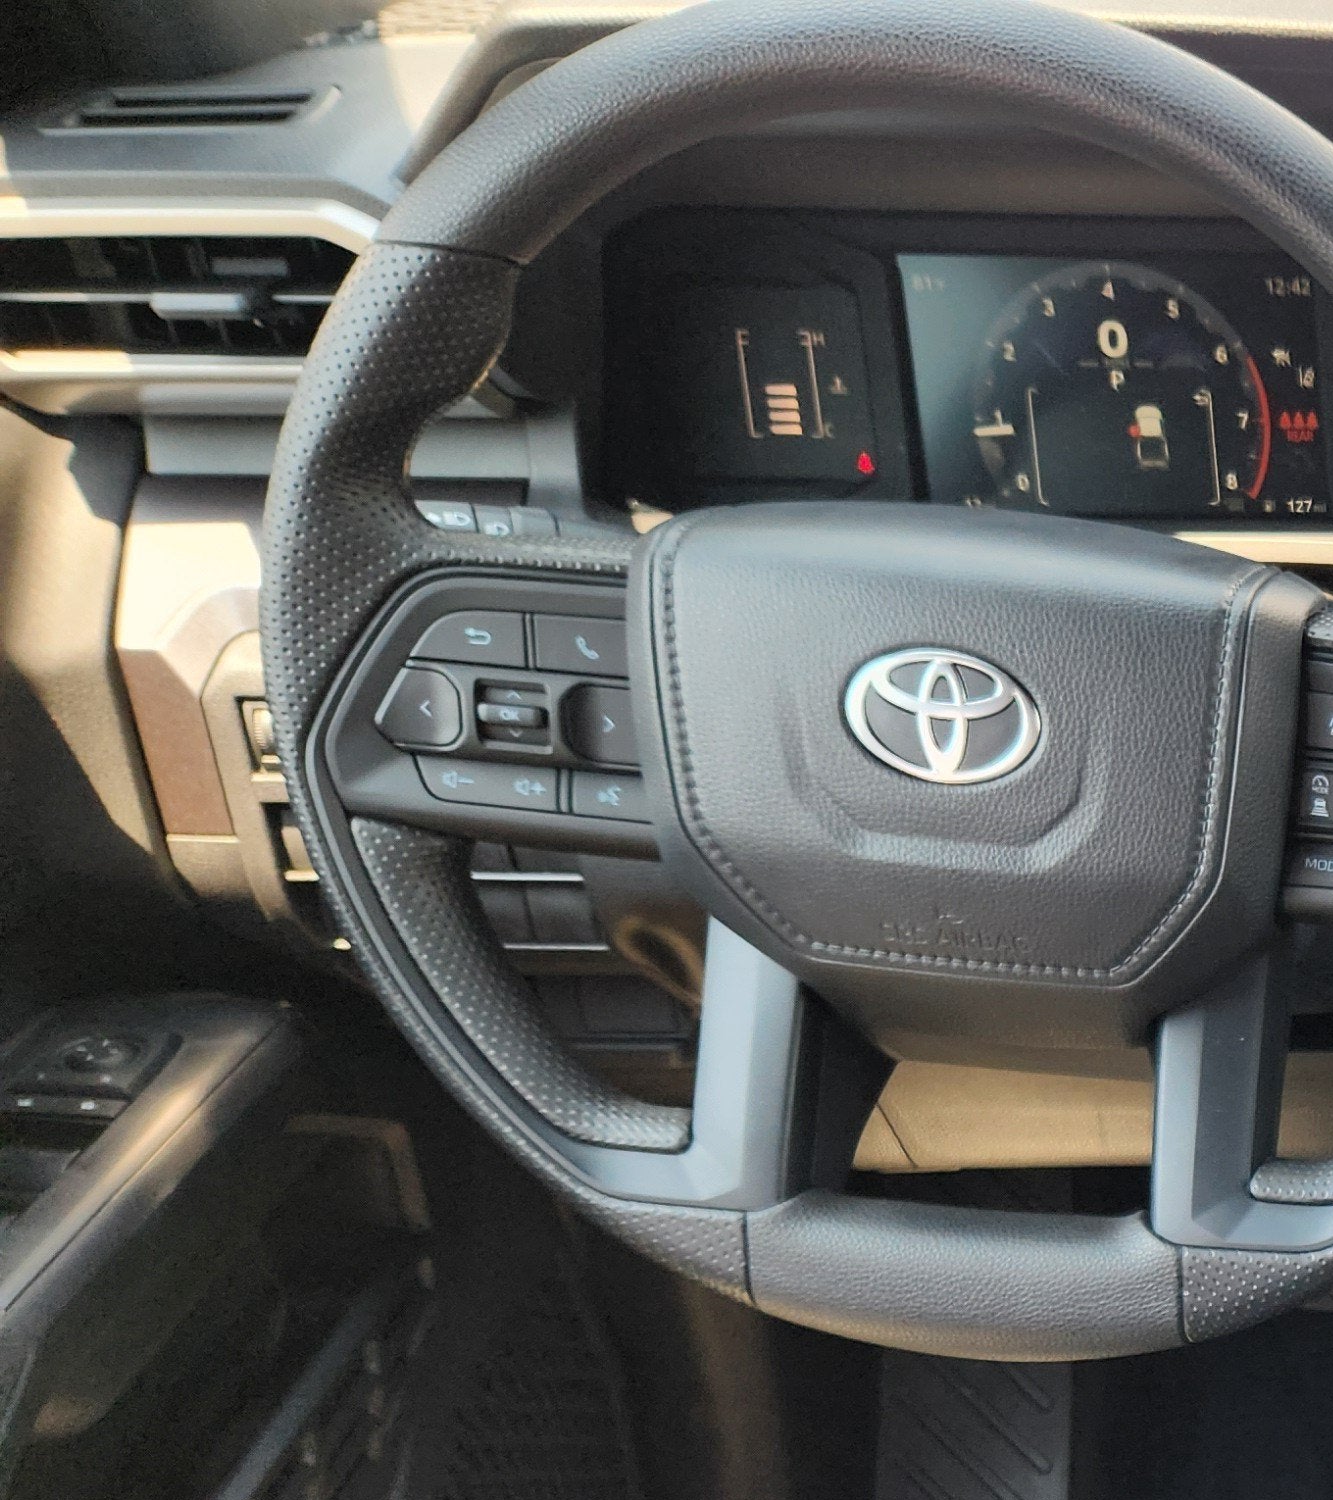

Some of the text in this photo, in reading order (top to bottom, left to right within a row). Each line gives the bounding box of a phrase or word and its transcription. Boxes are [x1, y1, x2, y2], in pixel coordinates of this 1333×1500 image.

[1265, 277, 1311, 297] 12:42
[1098, 319, 1128, 358] 0
[1285, 498, 1313, 513] 127
